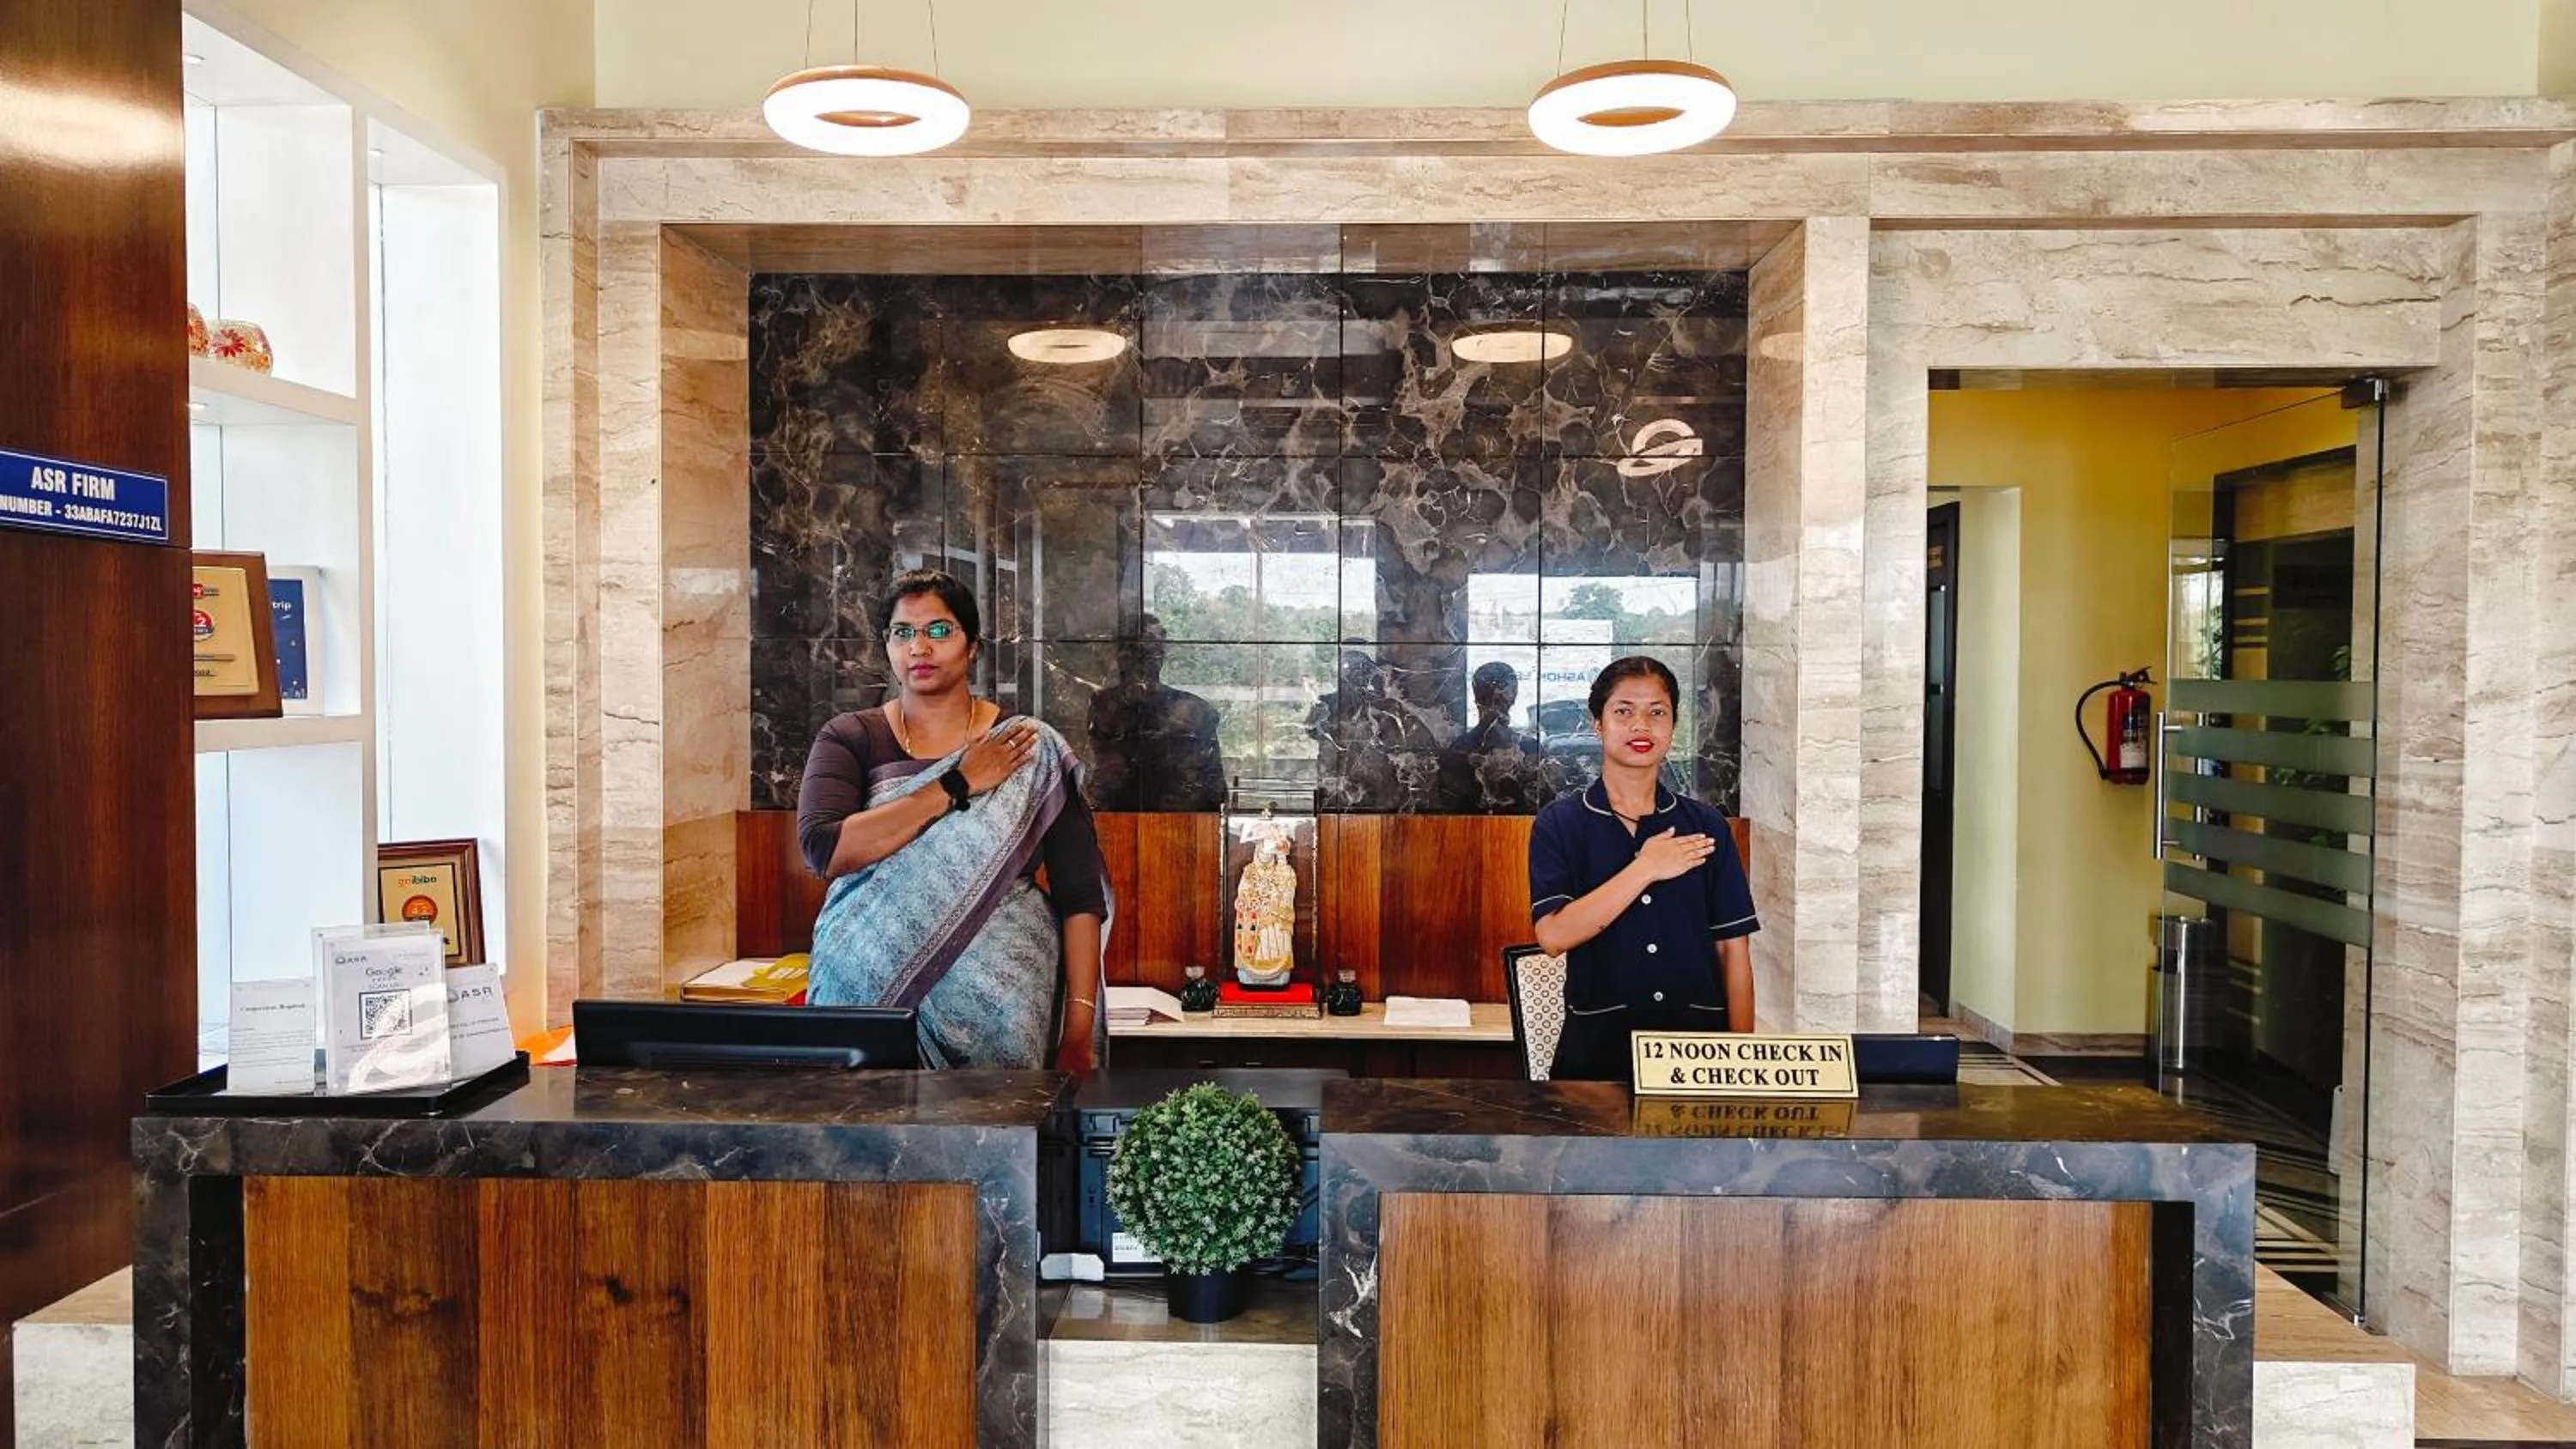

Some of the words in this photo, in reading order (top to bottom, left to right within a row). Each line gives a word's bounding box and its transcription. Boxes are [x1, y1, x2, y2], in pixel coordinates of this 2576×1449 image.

[31, 467, 67, 494] ASR
[71, 473, 116, 500] FIRM
[0, 494, 52, 516] NUMBER
[64, 504, 163, 530] 33ABAFA7237J1ZL
[1643, 1042, 1663, 1058] 12
[1669, 1042, 1731, 1060] NOON
[1737, 1044, 1816, 1061] CHECK
[1820, 1045, 1842, 1062] IN
[1670, 1067, 1686, 1084] &
[1692, 1068, 1770, 1085] CHECK
[1775, 1069, 1820, 1086] OUT
